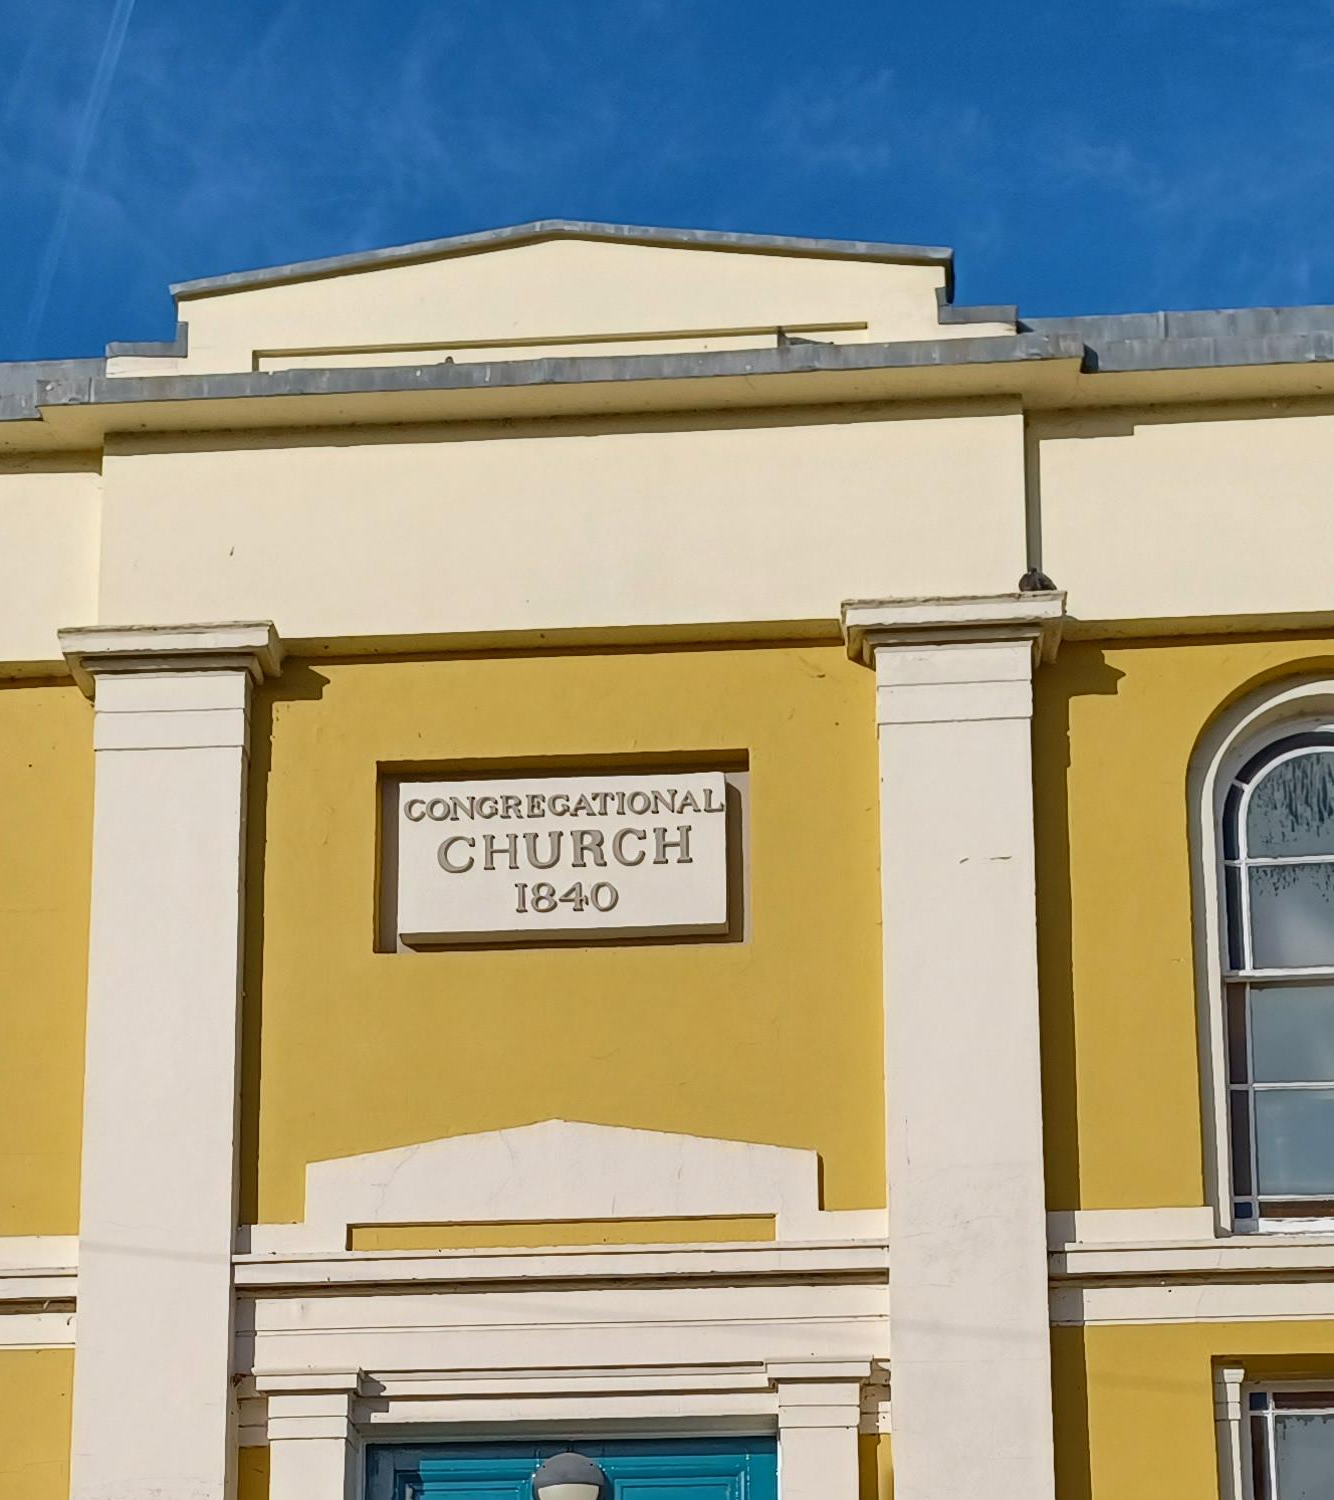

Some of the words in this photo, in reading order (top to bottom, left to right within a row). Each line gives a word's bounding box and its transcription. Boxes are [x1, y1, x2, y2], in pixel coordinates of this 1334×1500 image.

[403, 788, 725, 822] CONGREGATIONAL
[437, 825, 693, 873] CHURCH
[514, 881, 619, 913] 1840
